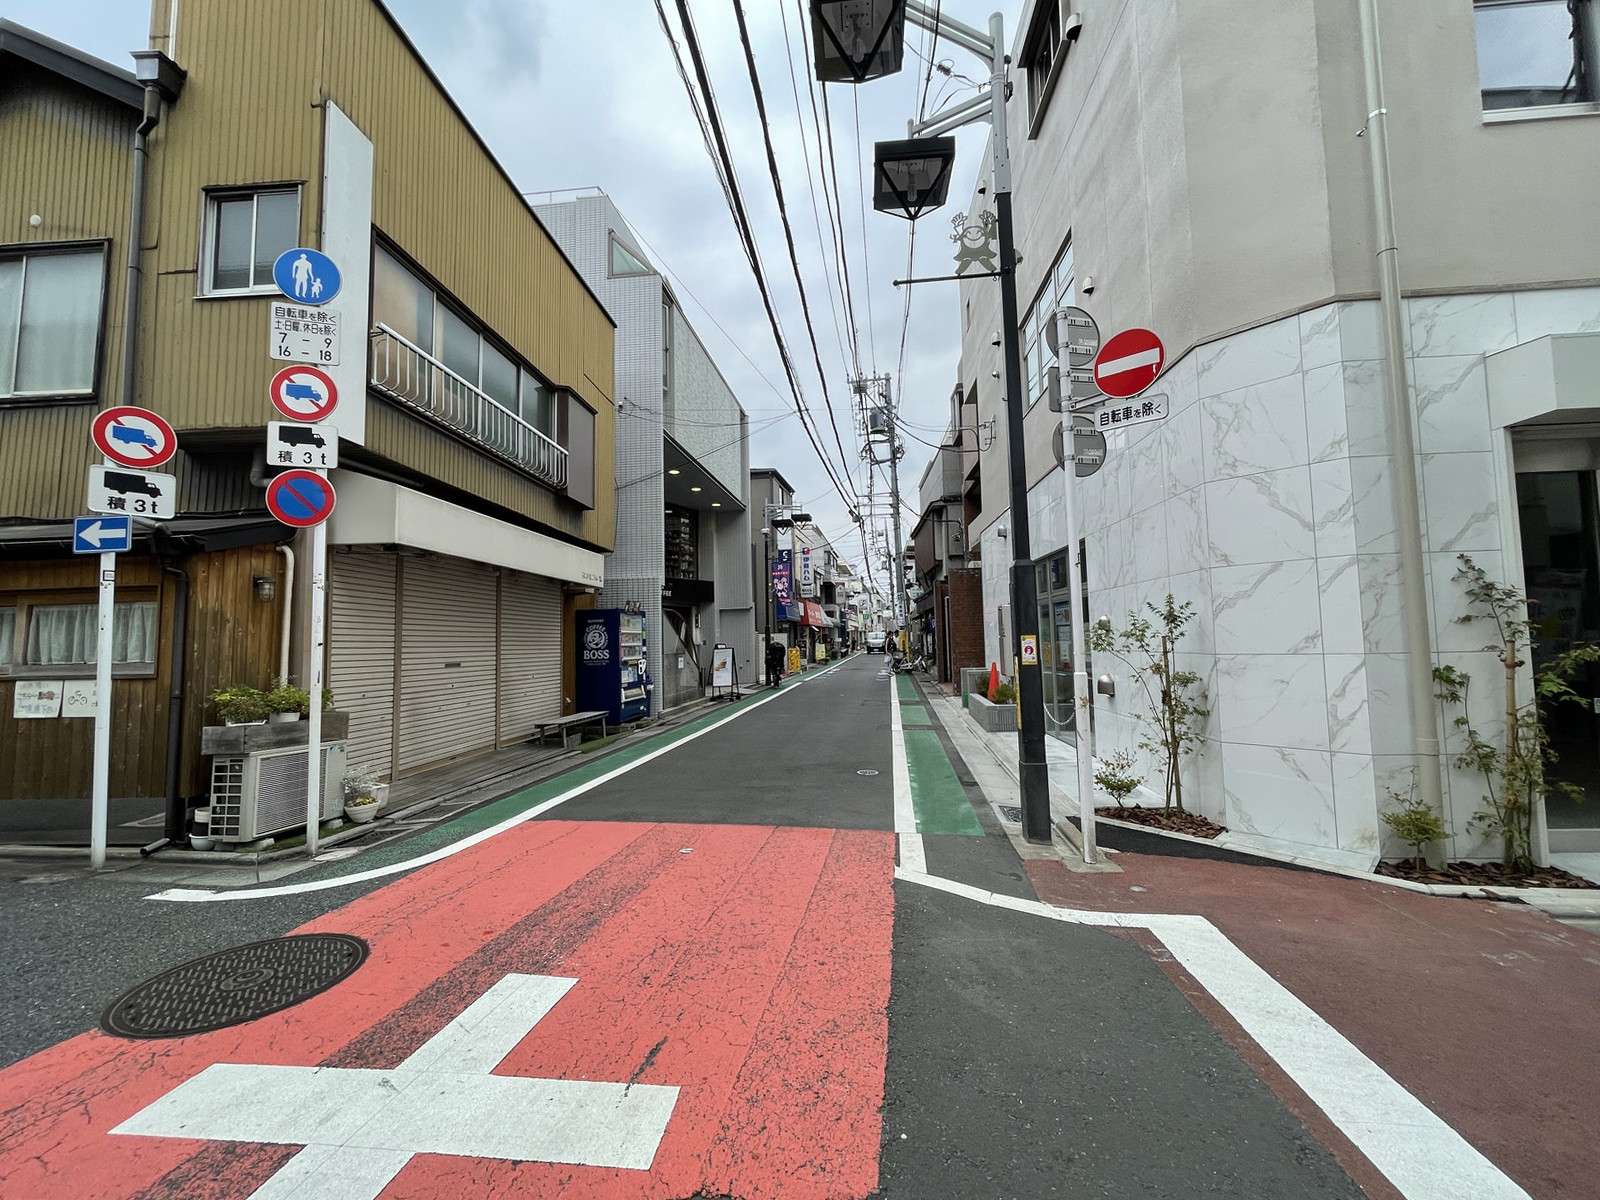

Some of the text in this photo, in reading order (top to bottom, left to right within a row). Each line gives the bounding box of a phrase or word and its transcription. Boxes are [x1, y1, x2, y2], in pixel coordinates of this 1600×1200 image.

[275, 307, 336, 323] 自転車を除く
[279, 332, 288, 343] 7
[324, 337, 332, 349] 9
[278, 345, 292, 357] 16
[319, 350, 332, 361] 18
[1099, 402, 1162, 427] 自転車を除く
[277, 450, 327, 465] 積 3 t
[106, 496, 158, 514] 積 3 t
[585, 624, 606, 633] COFFEE
[583, 649, 610, 660] BOSS
